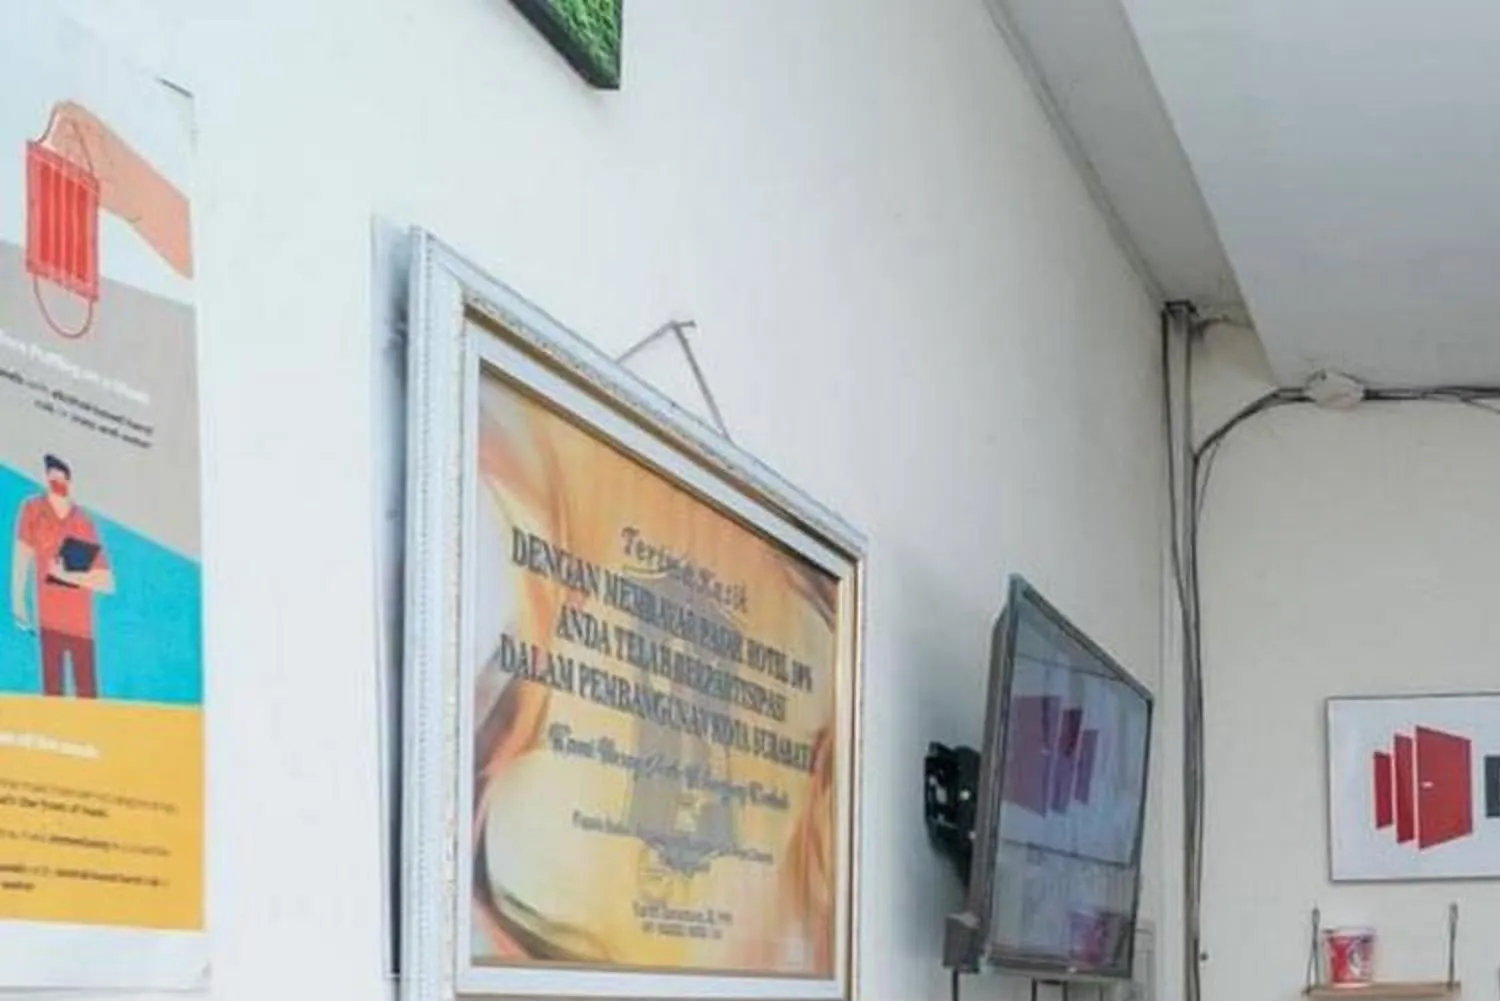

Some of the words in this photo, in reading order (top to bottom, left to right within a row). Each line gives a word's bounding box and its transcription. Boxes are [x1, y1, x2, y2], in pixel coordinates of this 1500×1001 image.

[511, 525, 600, 600] DENGAN
[746, 637, 789, 684] HOTEL
[556, 603, 611, 657] ANDA
[613, 624, 671, 680] TELAH
[501, 631, 574, 693] DALAM
[578, 660, 711, 740] PEMBANGUNAN
